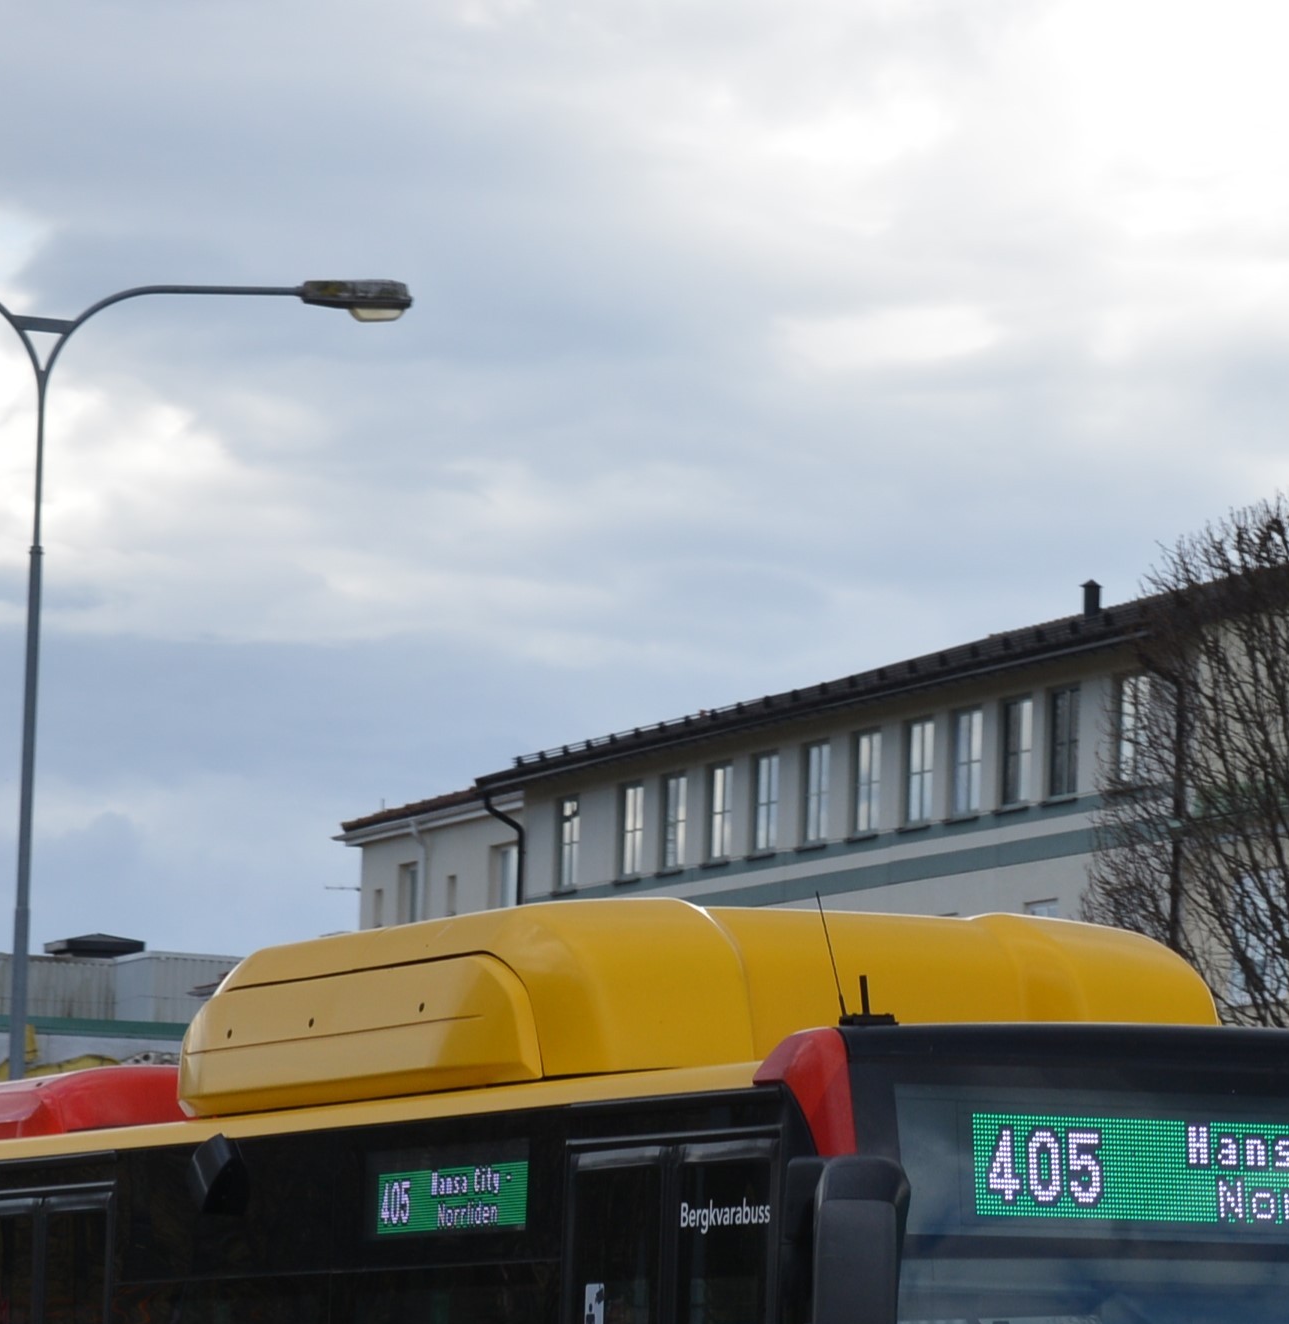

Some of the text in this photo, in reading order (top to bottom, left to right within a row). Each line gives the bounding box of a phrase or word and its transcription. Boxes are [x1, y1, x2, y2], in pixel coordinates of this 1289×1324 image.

[431, 1171, 468, 1196] Hansa
[474, 1167, 500, 1194] City
[989, 1130, 1101, 1203] 405
[381, 1180, 410, 1225] 405
[437, 1200, 498, 1227] Norrliden
[680, 1196, 771, 1235] Bergkvarabuss
